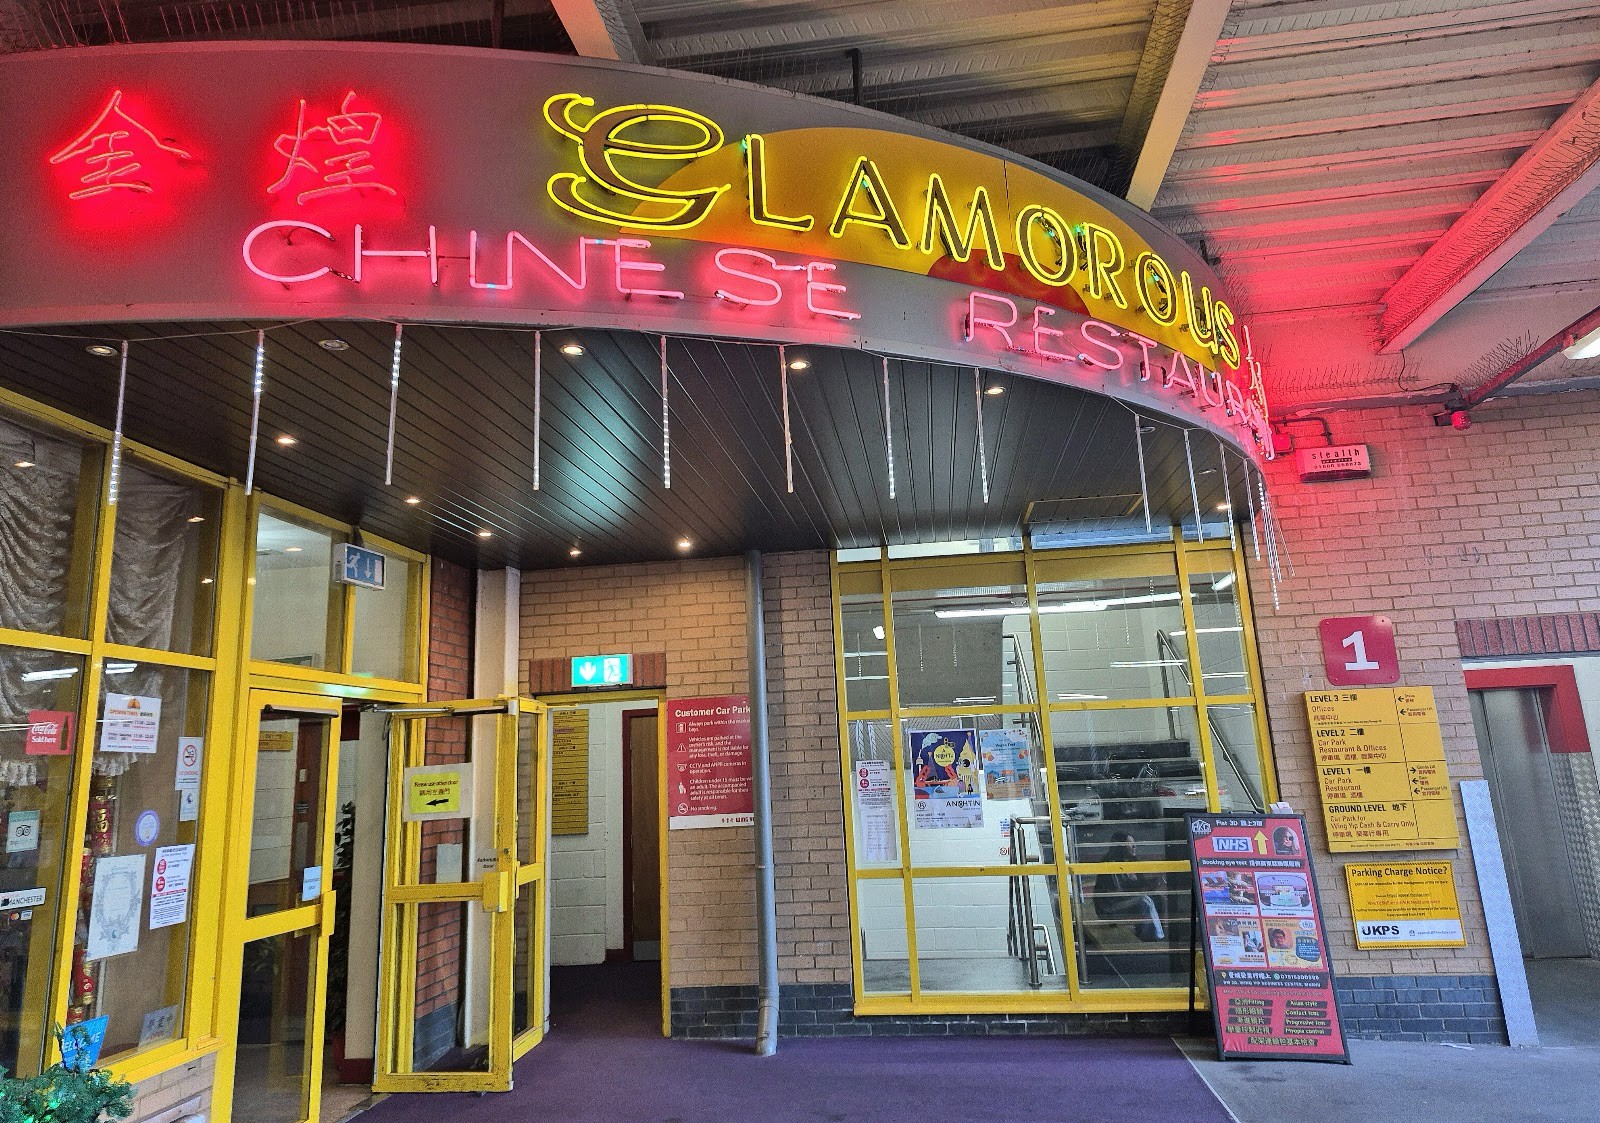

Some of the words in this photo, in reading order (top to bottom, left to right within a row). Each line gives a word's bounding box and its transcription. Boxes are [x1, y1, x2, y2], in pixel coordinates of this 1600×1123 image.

[242, 218, 862, 321] CHINESE
[1312, 449, 1360, 459] stealth
[1342, 630, 1380, 671] 1
[1310, 695, 1333, 703] LEVEL
[1334, 694, 1339, 702] 3
[675, 708, 714, 718] Customer
[716, 706, 730, 715] Car
[732, 705, 750, 714] Park
[1311, 705, 1335, 713] Offices
[1316, 729, 1339, 738] LEVEL
[1340, 729, 1346, 737] 2
[31, 735, 45, 743] Sold
[1319, 745, 1355, 754] Restaurant
[1363, 744, 1387, 752] Offices
[1322, 767, 1346, 776] LEVEL
[1347, 767, 1351, 775] 1
[1325, 784, 1361, 792] Restaurant
[1328, 805, 1362, 814] GROUND
[1364, 804, 1387, 812] LEVEL
[1331, 823, 1348, 831] Wing
[1349, 822, 1359, 830] Yip
[1382, 821, 1400, 829] Carry
[1401, 820, 1415, 828] Only
[1219, 839, 1248, 850] NHS
[1351, 869, 1382, 878] Parking
[1384, 867, 1413, 877] Charge
[1415, 866, 1448, 876] Notice?
[1362, 925, 1400, 936] UKPS
[1285, 1019, 1314, 1027] Progressive
[1285, 1027, 1305, 1035] Myopia
